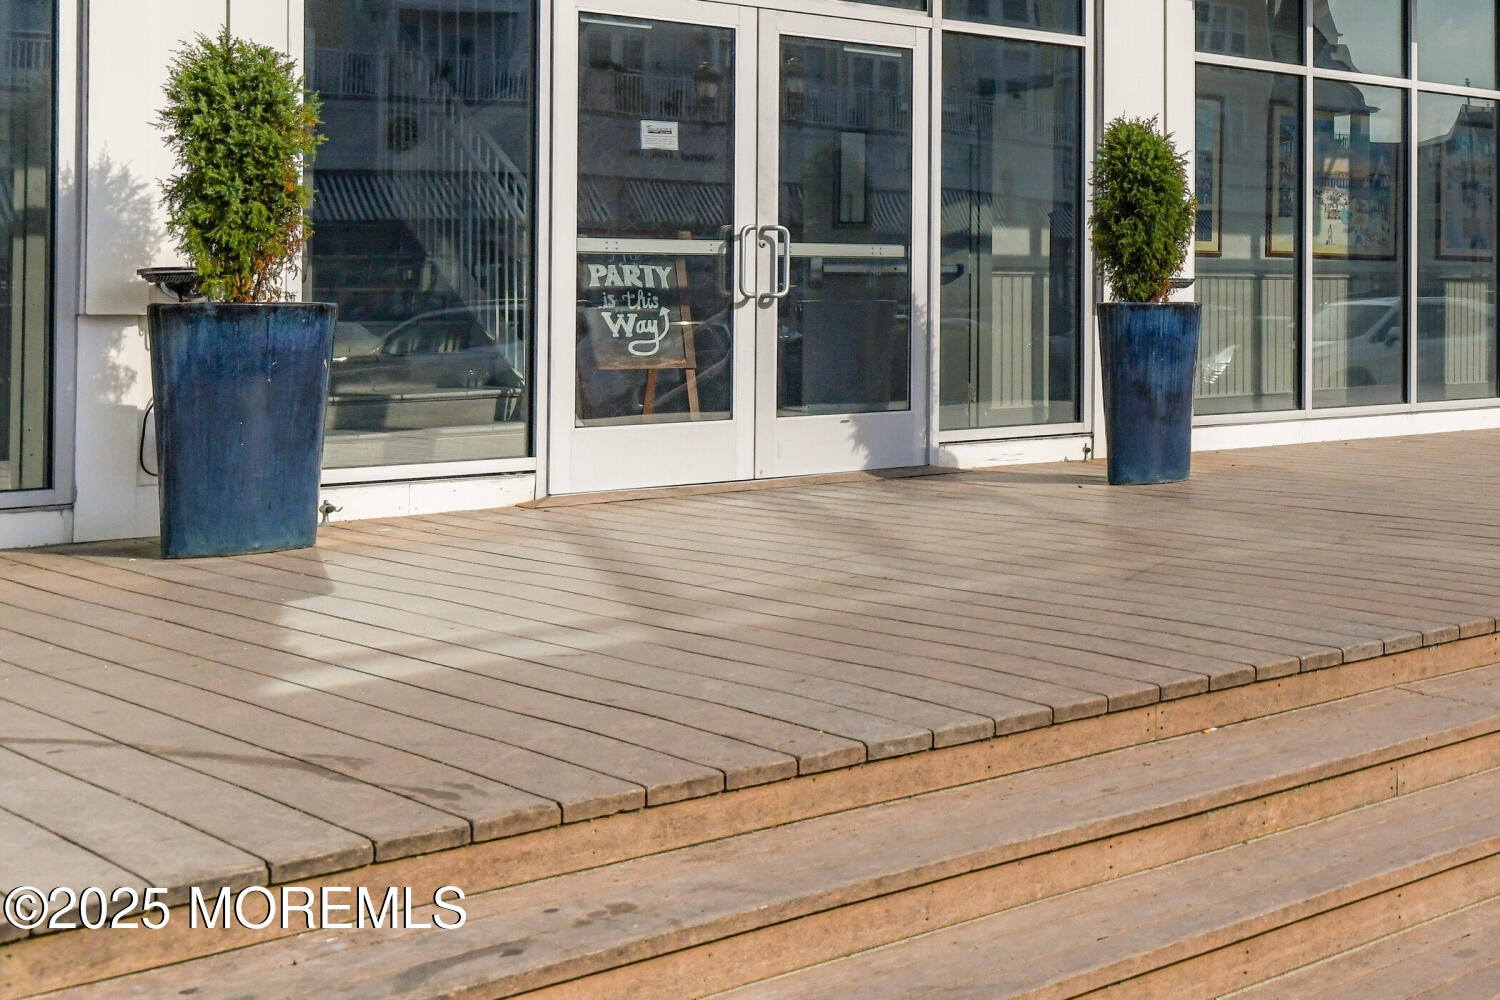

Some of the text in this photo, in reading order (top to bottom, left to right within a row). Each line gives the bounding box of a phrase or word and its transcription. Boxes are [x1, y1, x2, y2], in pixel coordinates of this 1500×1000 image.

[587, 263, 672, 289] PARTY
[602, 289, 659, 310] is this
